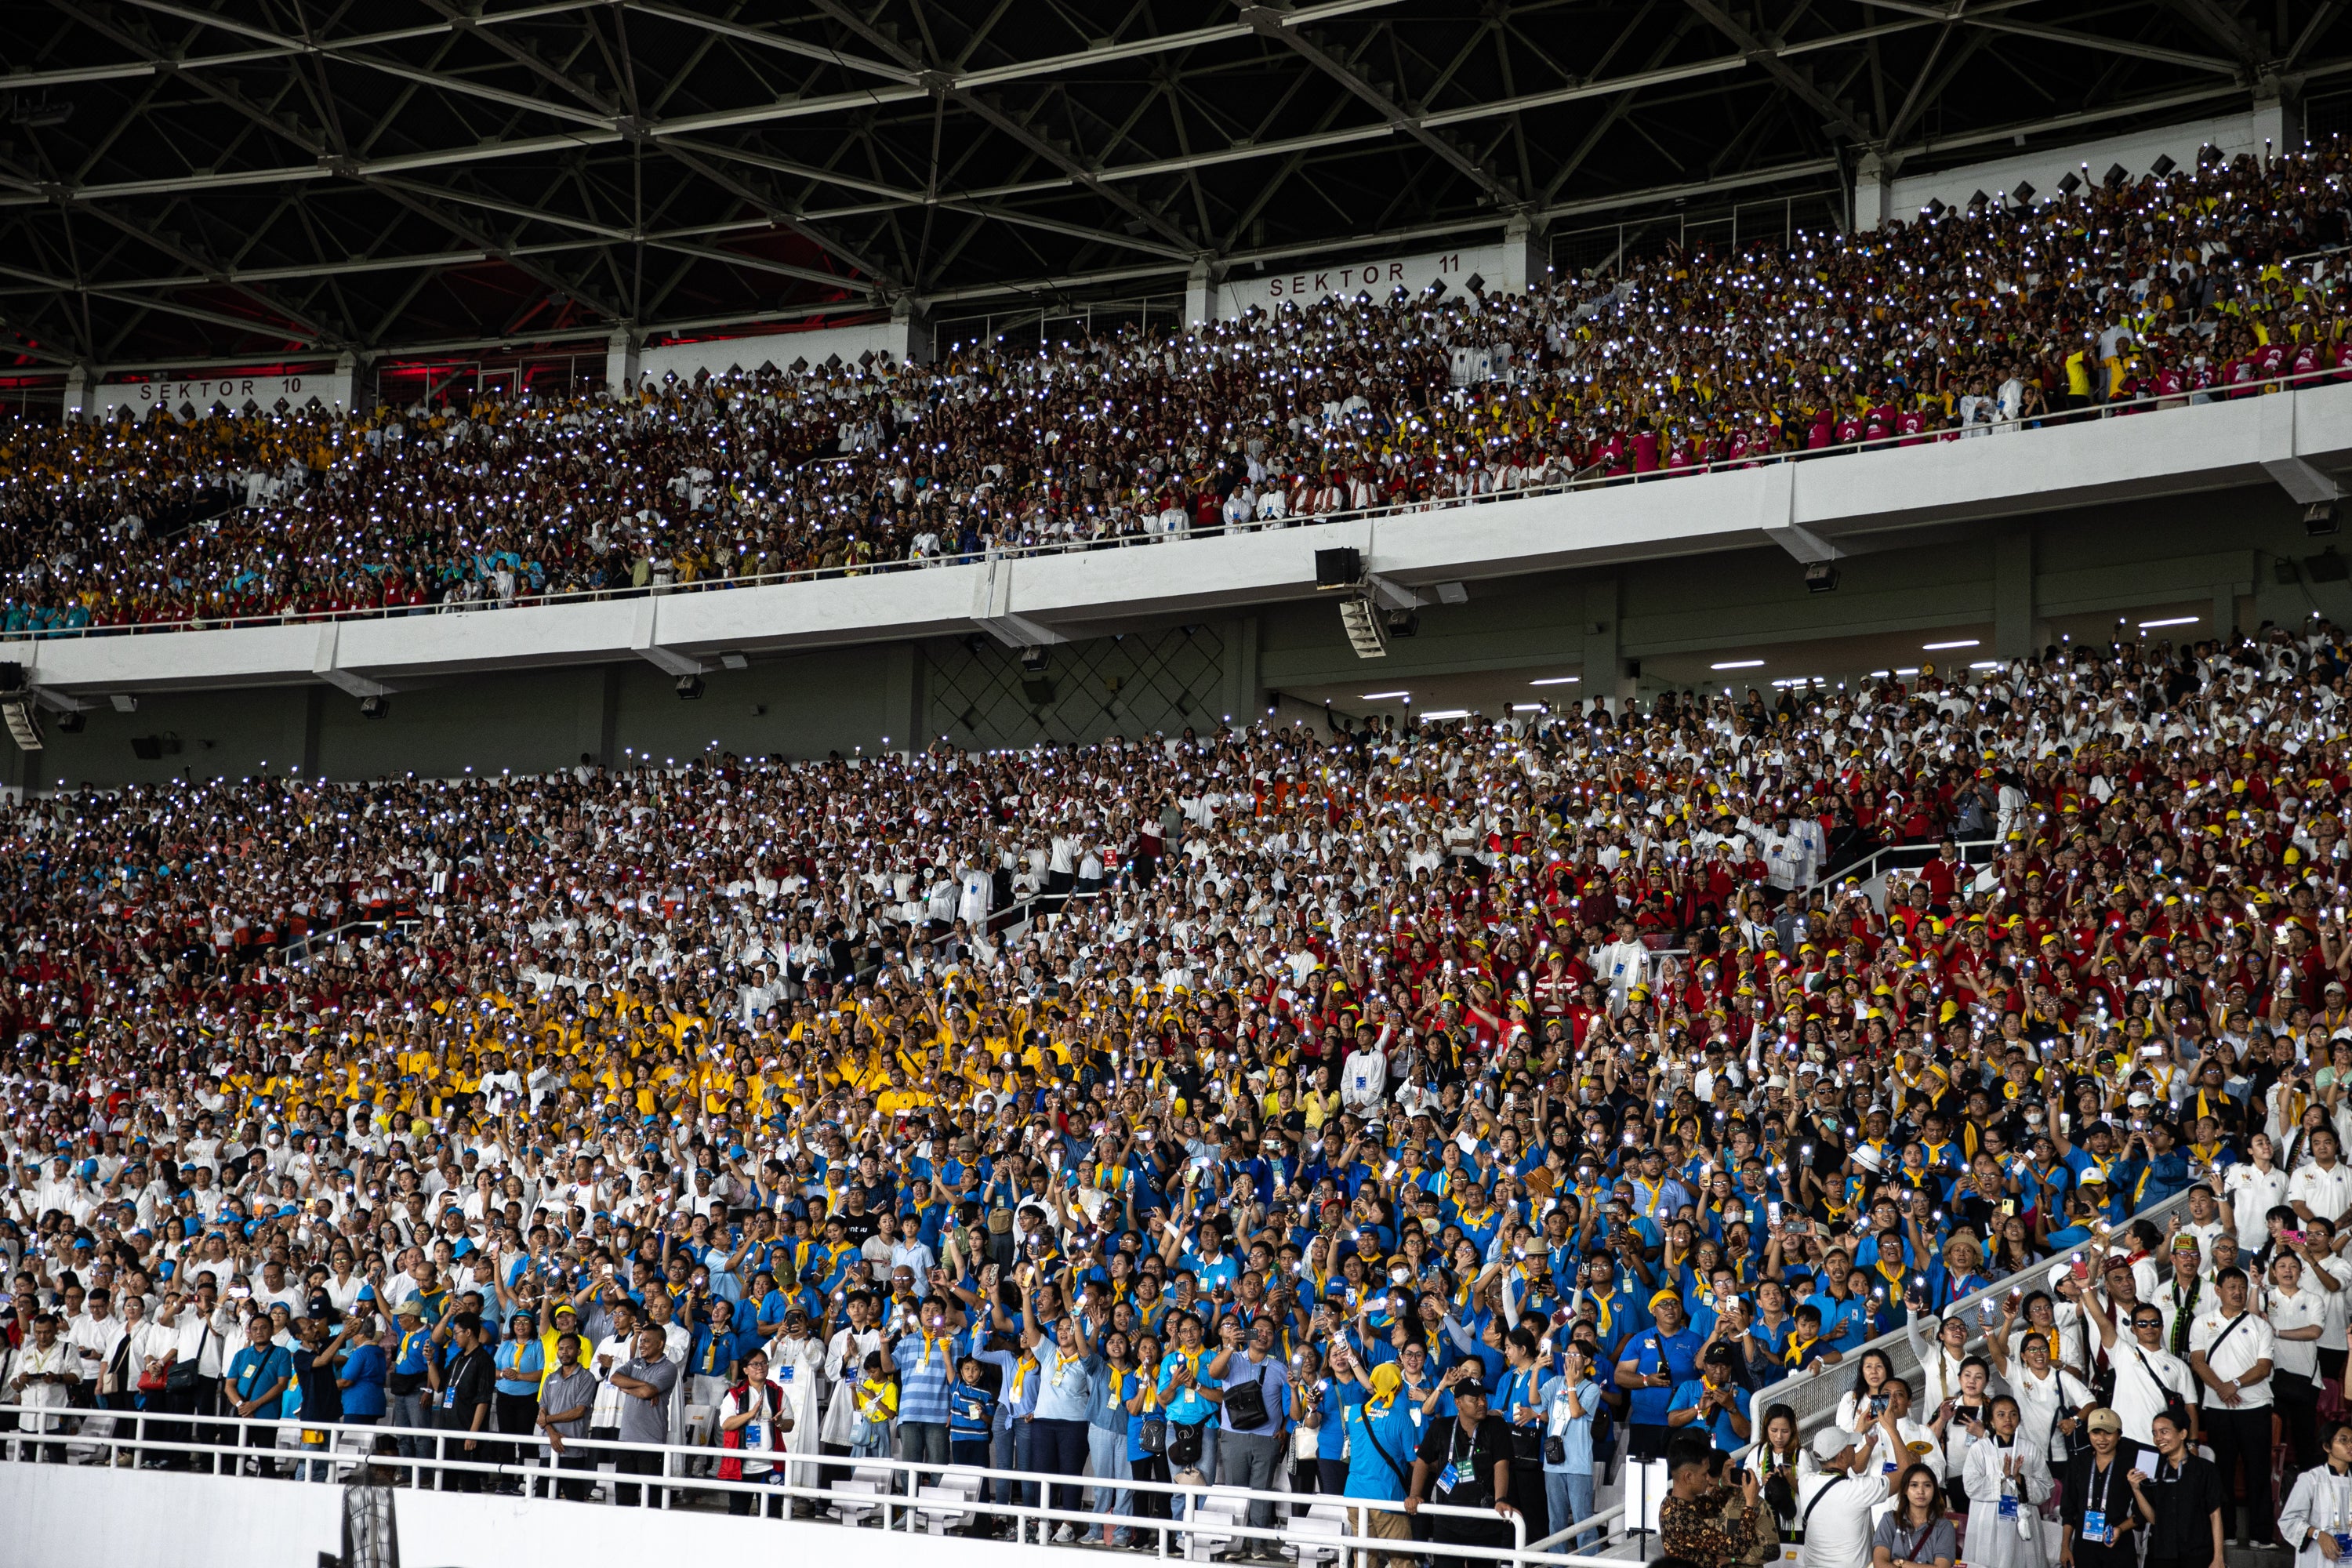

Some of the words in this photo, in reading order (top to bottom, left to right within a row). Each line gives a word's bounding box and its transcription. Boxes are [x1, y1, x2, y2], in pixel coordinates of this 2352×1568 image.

[1270, 263, 1403, 296] SEKTOR
[1439, 254, 1458, 273] 11
[140, 380, 253, 399] SEKTOR
[282, 378, 301, 393] 10
